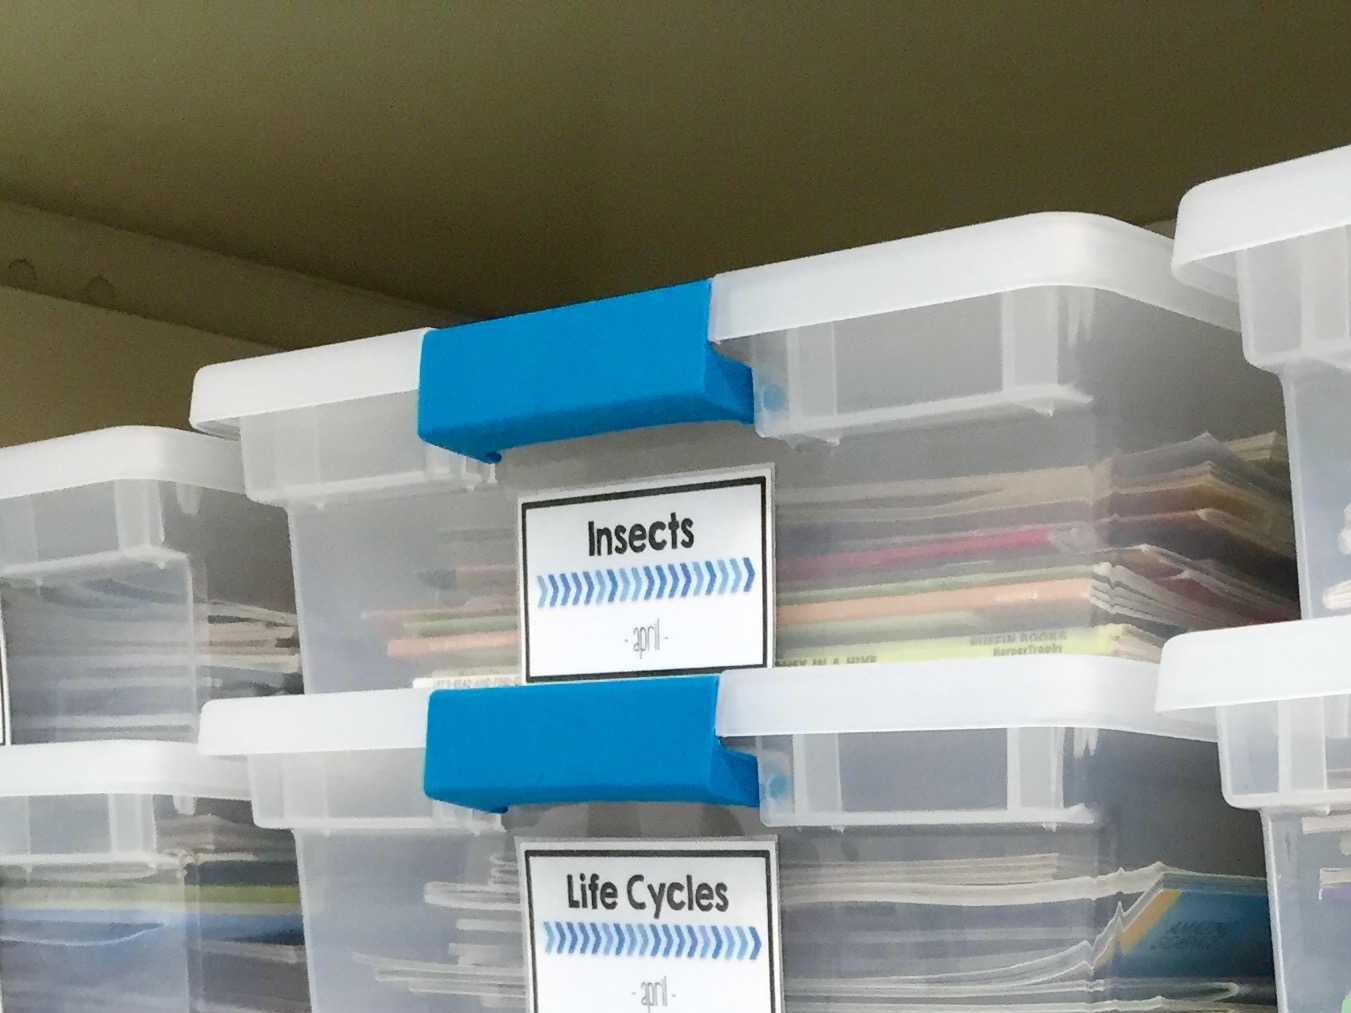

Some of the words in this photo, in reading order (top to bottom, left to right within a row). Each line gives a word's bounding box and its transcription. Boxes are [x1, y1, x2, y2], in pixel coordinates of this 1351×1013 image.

[587, 511, 695, 557] Insects
[566, 872, 619, 911] Life
[626, 873, 730, 920] Cycles
